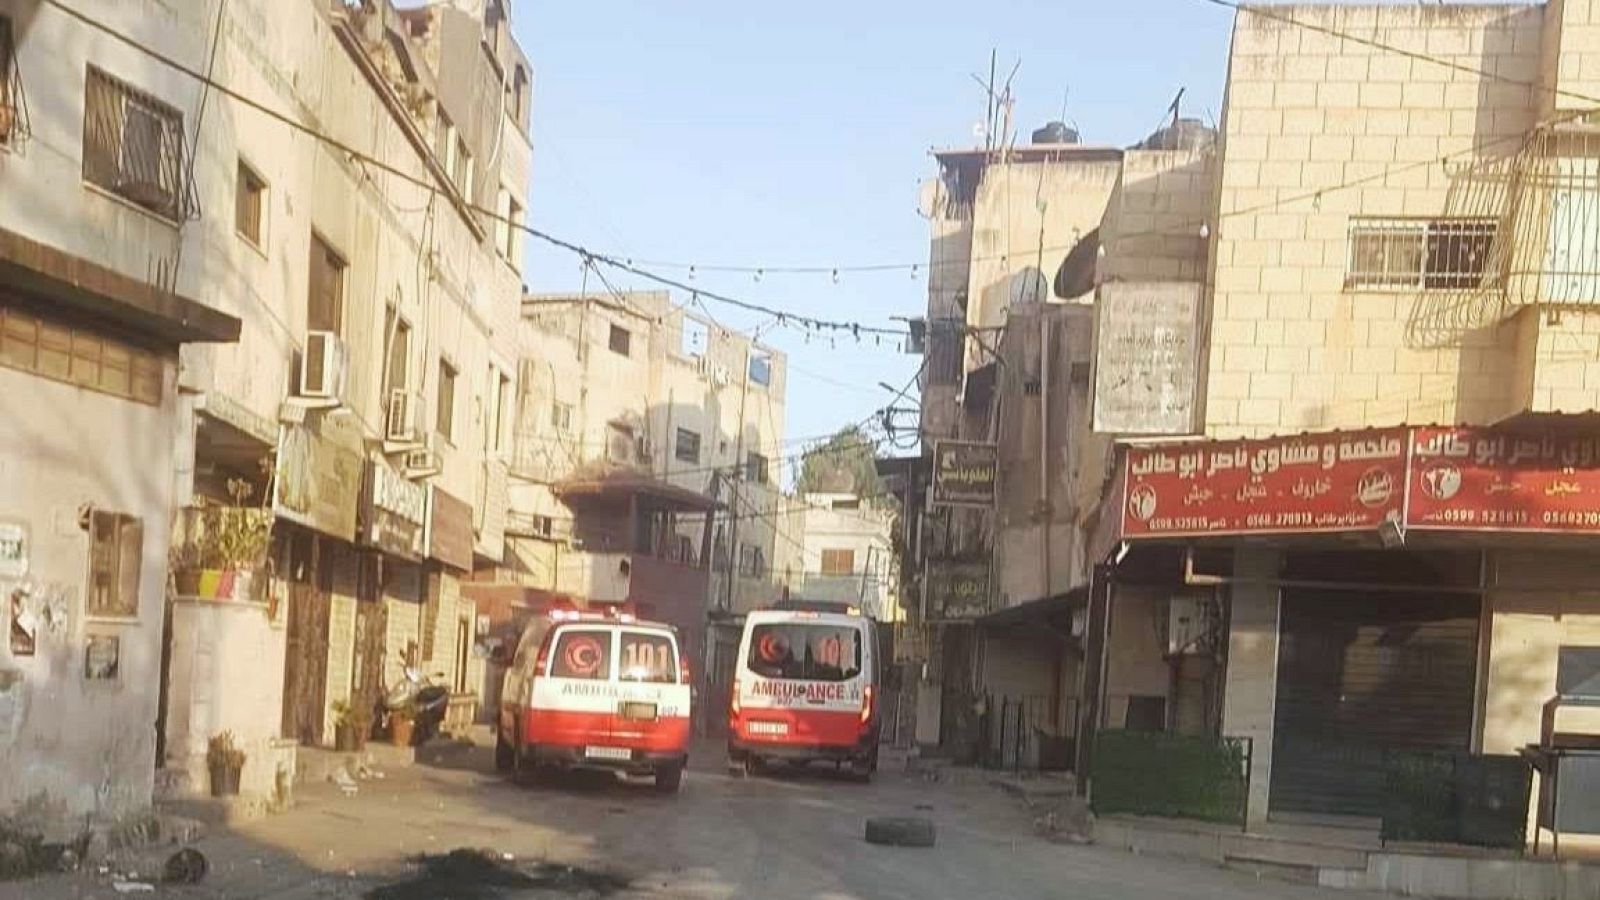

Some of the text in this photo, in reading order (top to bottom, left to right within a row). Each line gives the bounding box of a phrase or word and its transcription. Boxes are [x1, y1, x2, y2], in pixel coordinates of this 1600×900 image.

[1206, 445, 1248, 478] ناصر
[1250, 438, 1319, 483] مشاوي
[1322, 443, 1335, 469] و
[1339, 435, 1400, 461] ملحمة
[1131, 452, 1176, 481] طالب
[625, 642, 669, 680] 101
